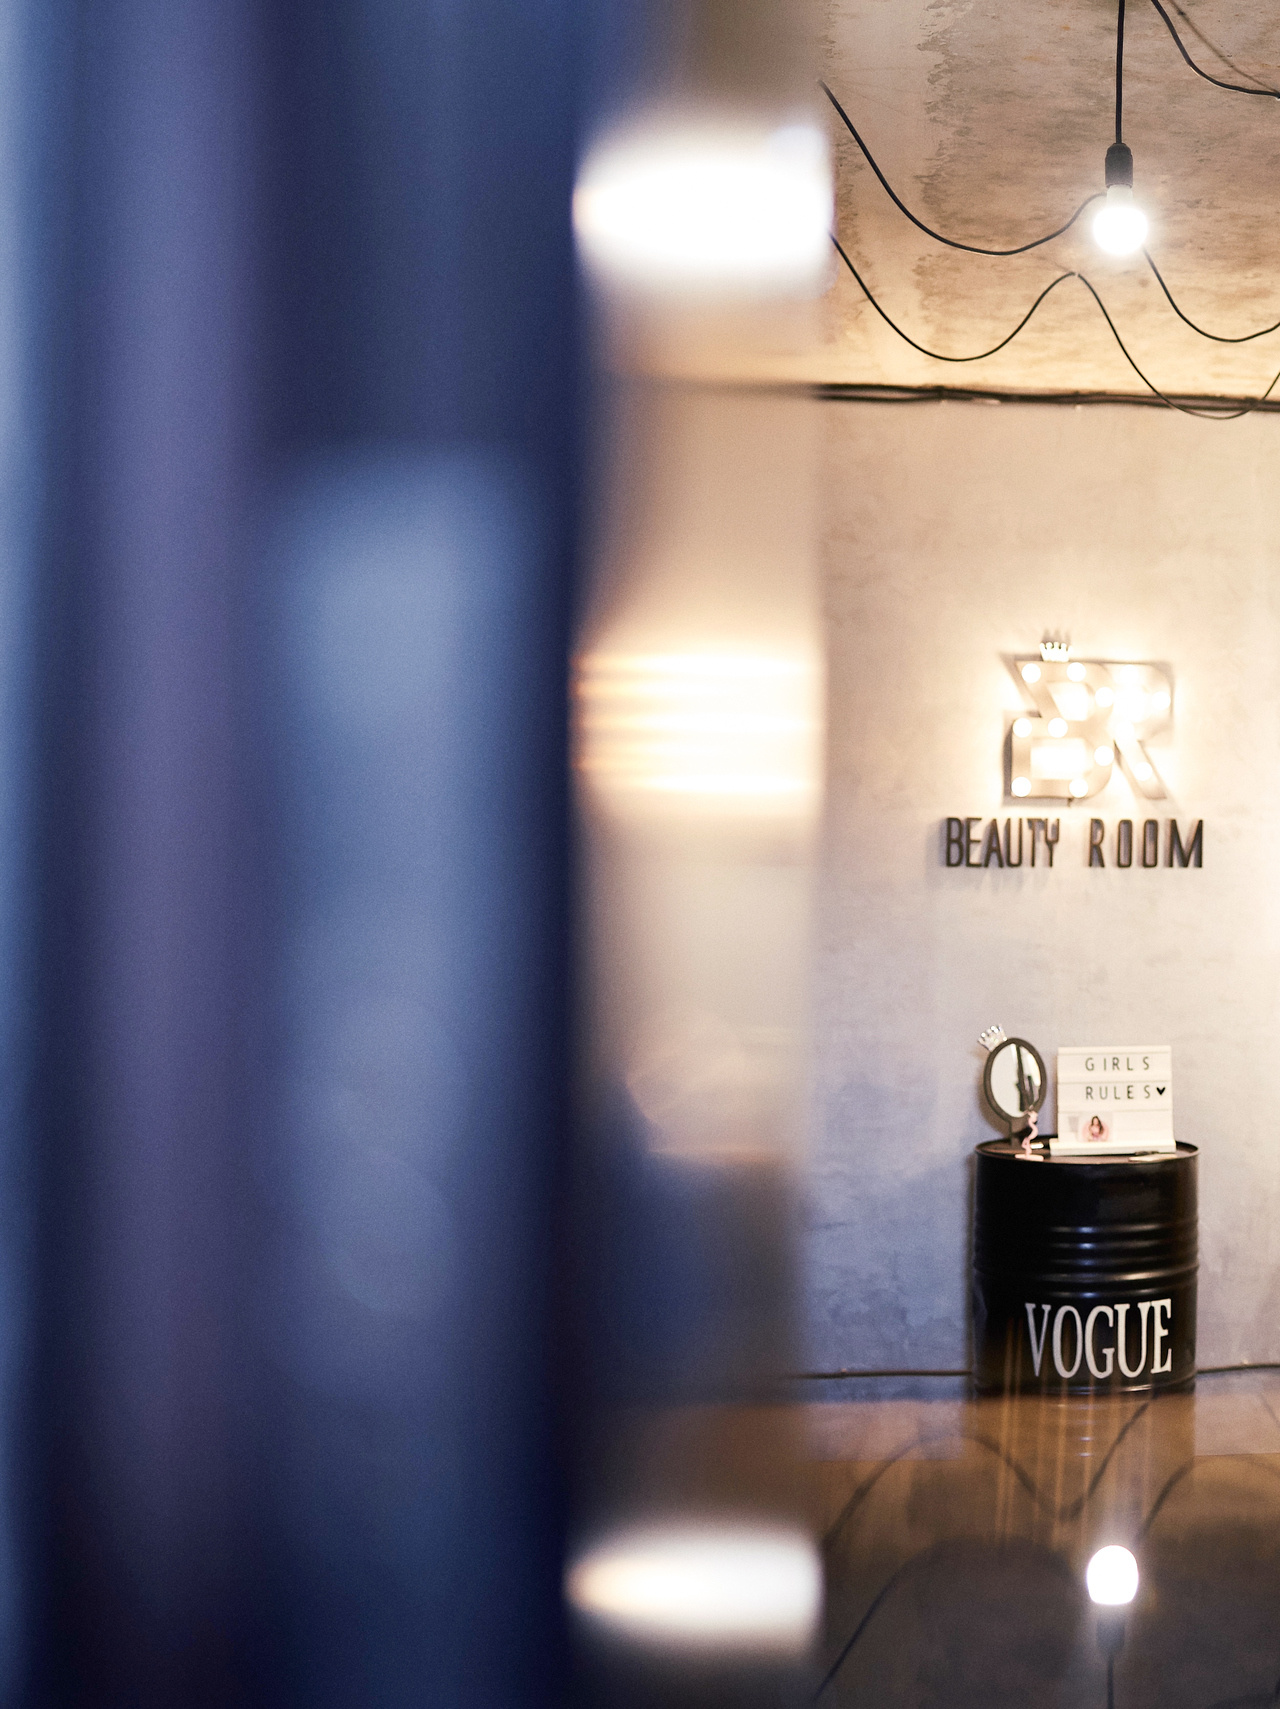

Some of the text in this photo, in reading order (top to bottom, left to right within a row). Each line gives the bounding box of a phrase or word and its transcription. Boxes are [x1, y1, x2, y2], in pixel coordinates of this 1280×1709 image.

[944, 816, 1204, 868] BEAUTY ROOM
[1085, 1056, 1150, 1072] GIRLS
[1085, 1084, 1151, 1100] RULES
[1024, 1298, 1172, 1379] VOGUE
